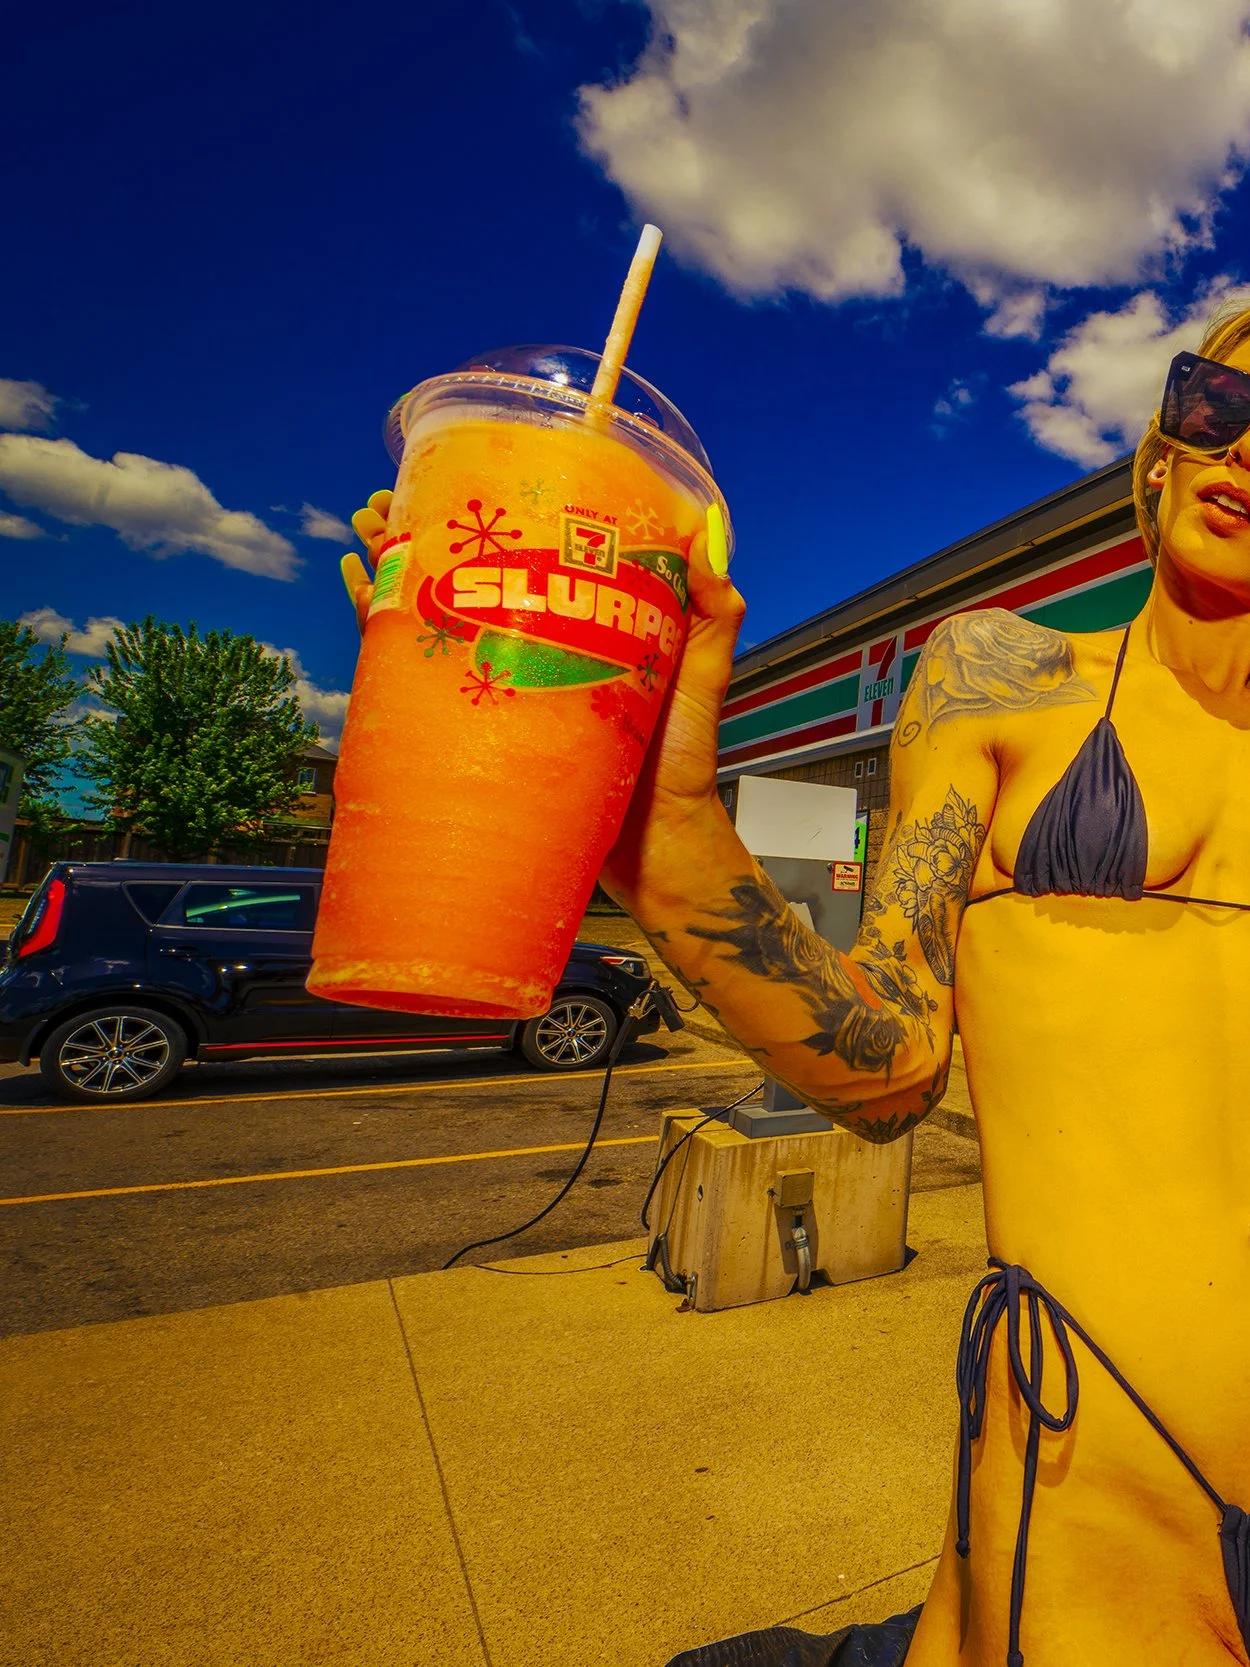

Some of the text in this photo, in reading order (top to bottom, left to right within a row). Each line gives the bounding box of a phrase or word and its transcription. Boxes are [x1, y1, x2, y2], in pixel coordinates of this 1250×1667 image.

[564, 504, 617, 525] ONLY AT
[575, 527, 606, 566] 7
[868, 634, 898, 728] 7
